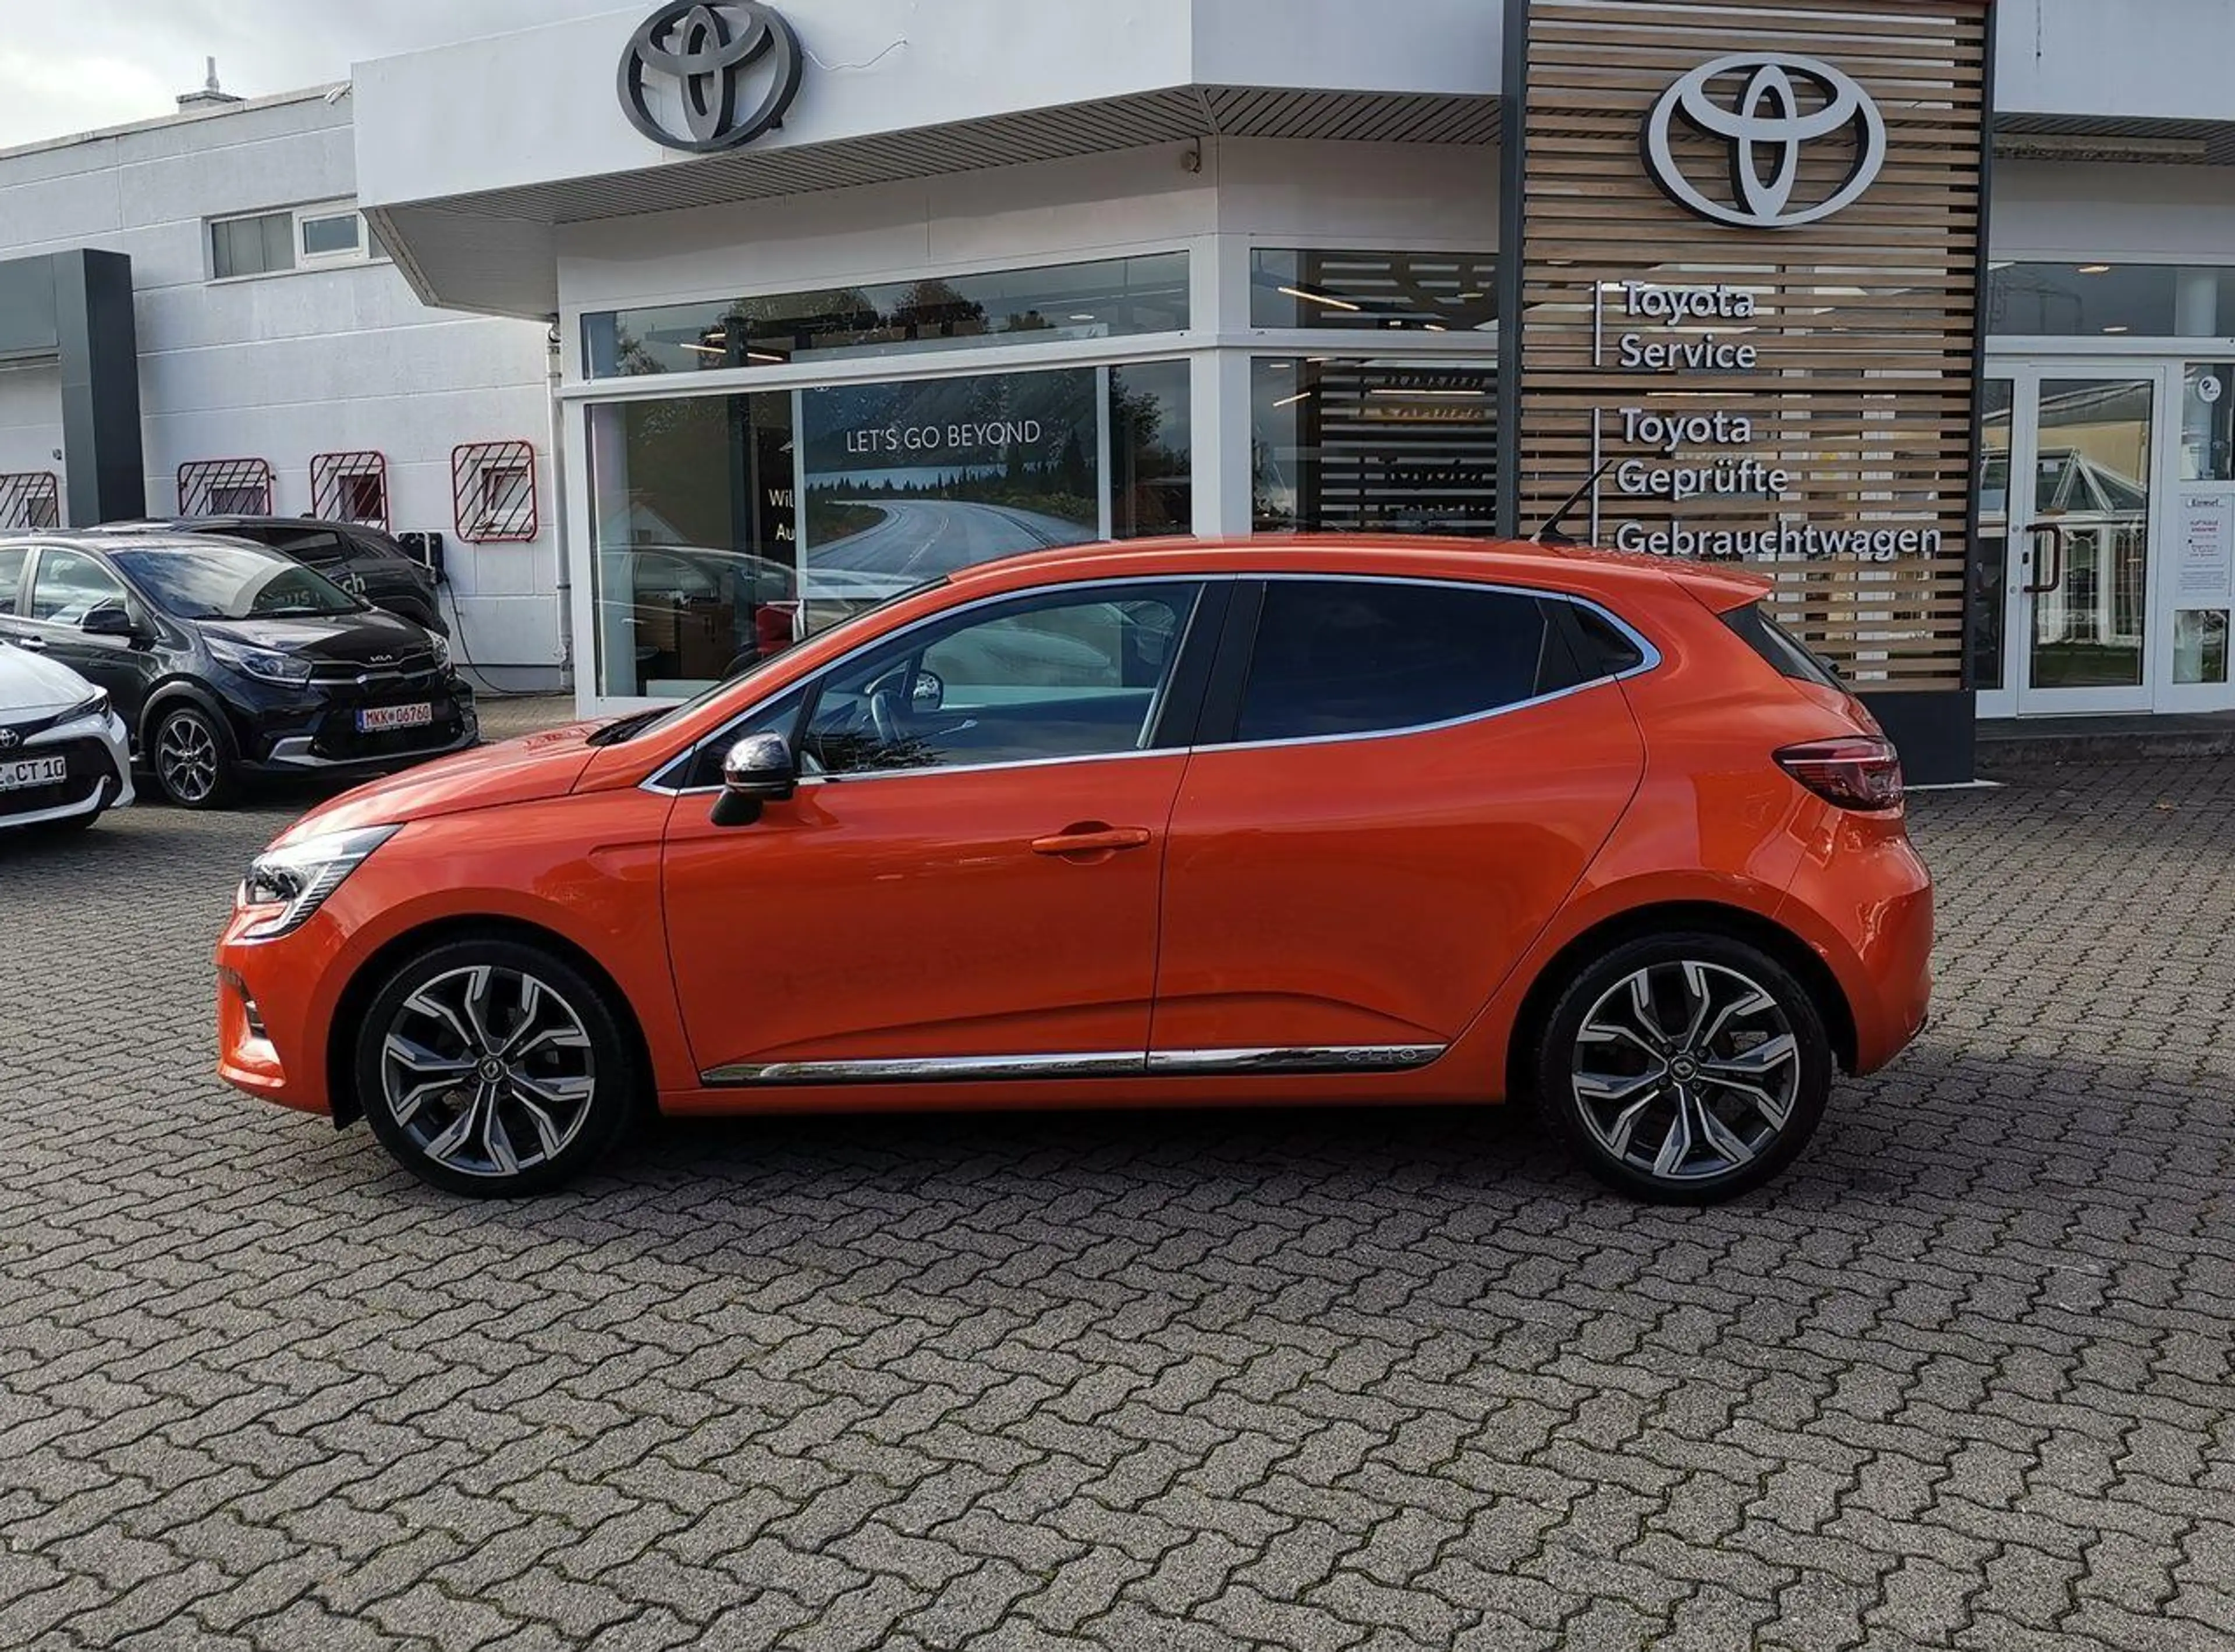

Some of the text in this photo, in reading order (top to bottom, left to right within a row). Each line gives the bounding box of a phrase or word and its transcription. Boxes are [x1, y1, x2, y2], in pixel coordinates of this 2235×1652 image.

[1621, 279, 1755, 327] Toyota
[1620, 332, 1757, 368] Service
[846, 420, 1041, 452] LET'S GO BEYOND
[1618, 407, 1751, 452] Toyota
[1616, 458, 1789, 501] Geprüfte
[1616, 521, 1942, 562] Gebrauchtwagen
[366, 705, 430, 725] MKK 06760
[15, 762, 38, 781] CT
[43, 759, 63, 778] 10
[1344, 1048, 1417, 1062] CLIO
